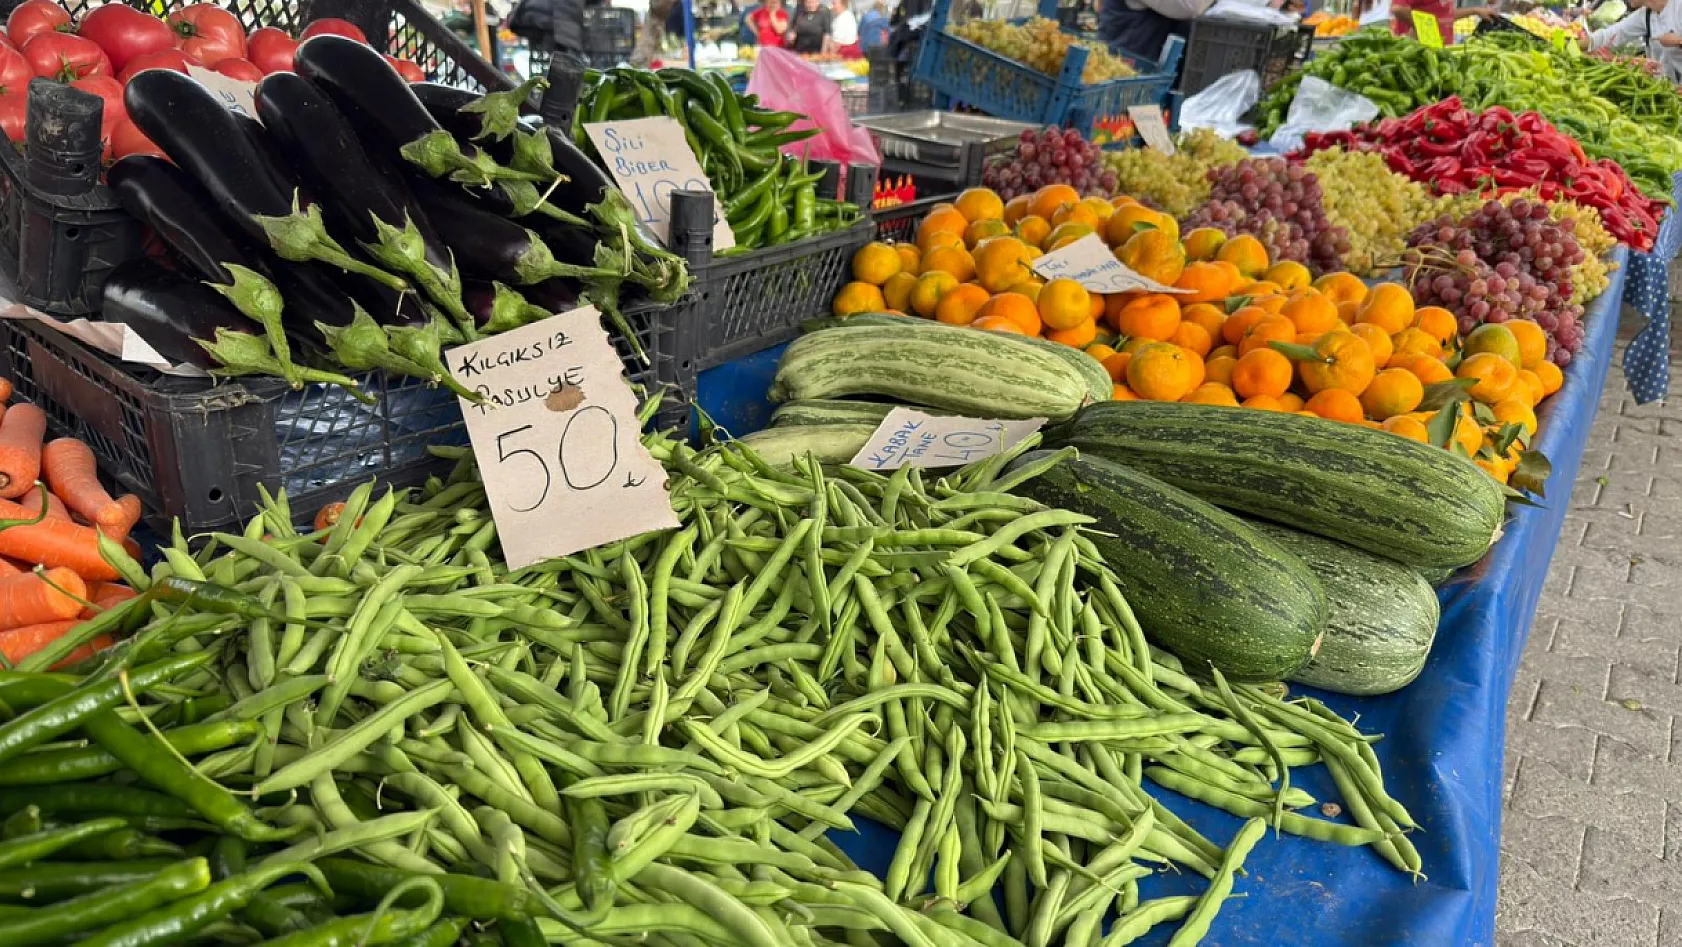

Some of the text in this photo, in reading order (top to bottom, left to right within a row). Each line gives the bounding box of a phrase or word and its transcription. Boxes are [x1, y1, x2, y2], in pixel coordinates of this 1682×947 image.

[497, 405, 618, 513] 50
[868, 420, 924, 469] KABAK
[896, 431, 938, 464] TANE
